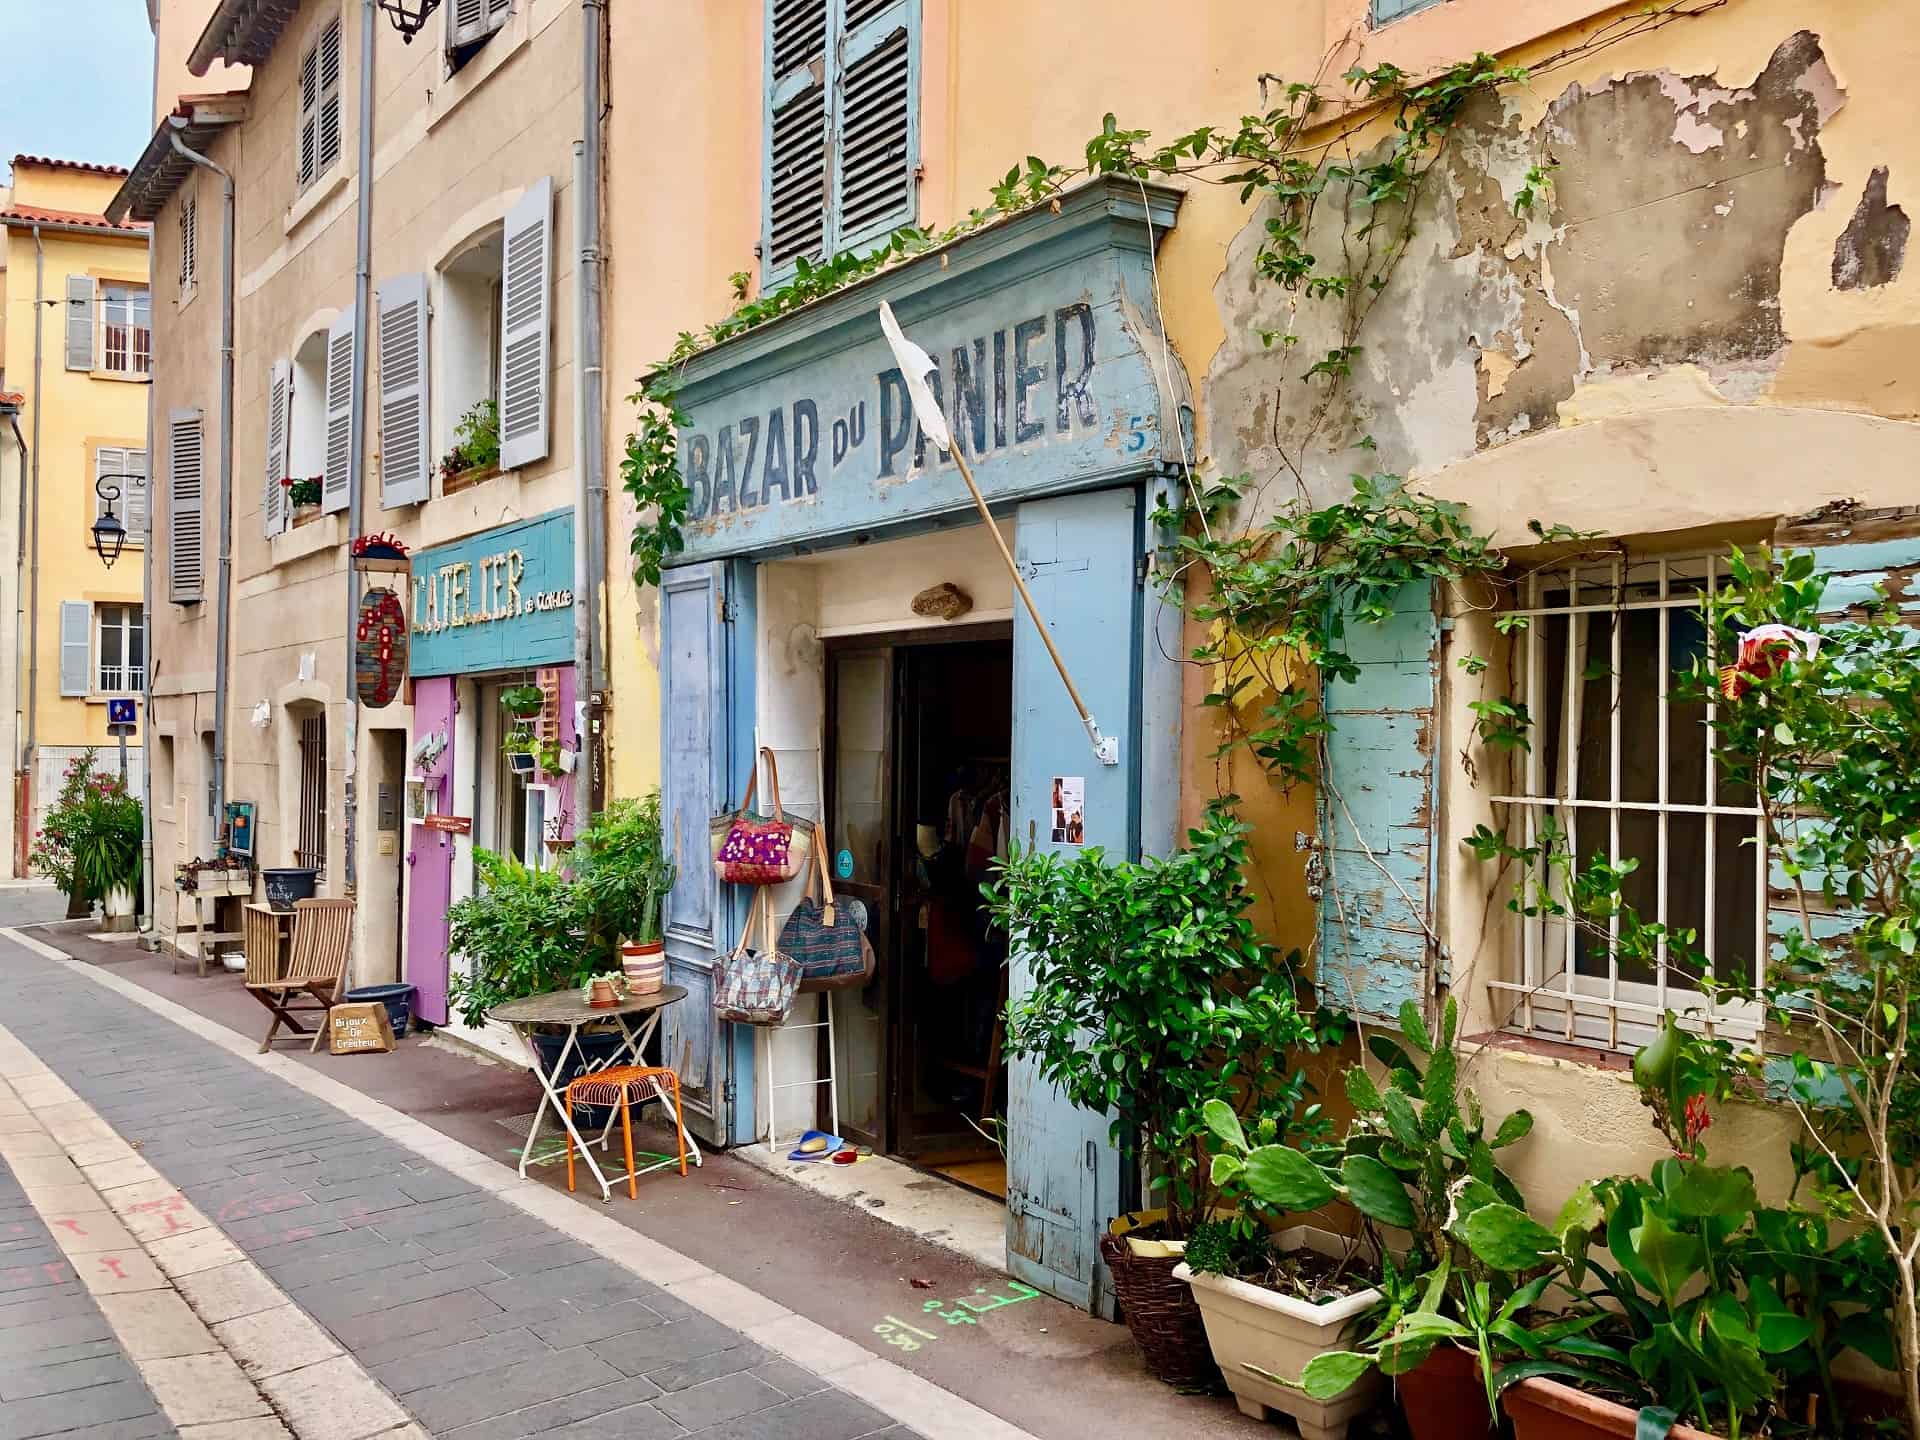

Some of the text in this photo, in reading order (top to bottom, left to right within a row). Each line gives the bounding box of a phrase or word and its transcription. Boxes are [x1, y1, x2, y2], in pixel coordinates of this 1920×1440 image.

[686, 398, 819, 520] BAZAR
[832, 400, 866, 468] DU
[1127, 415, 1145, 452] 5
